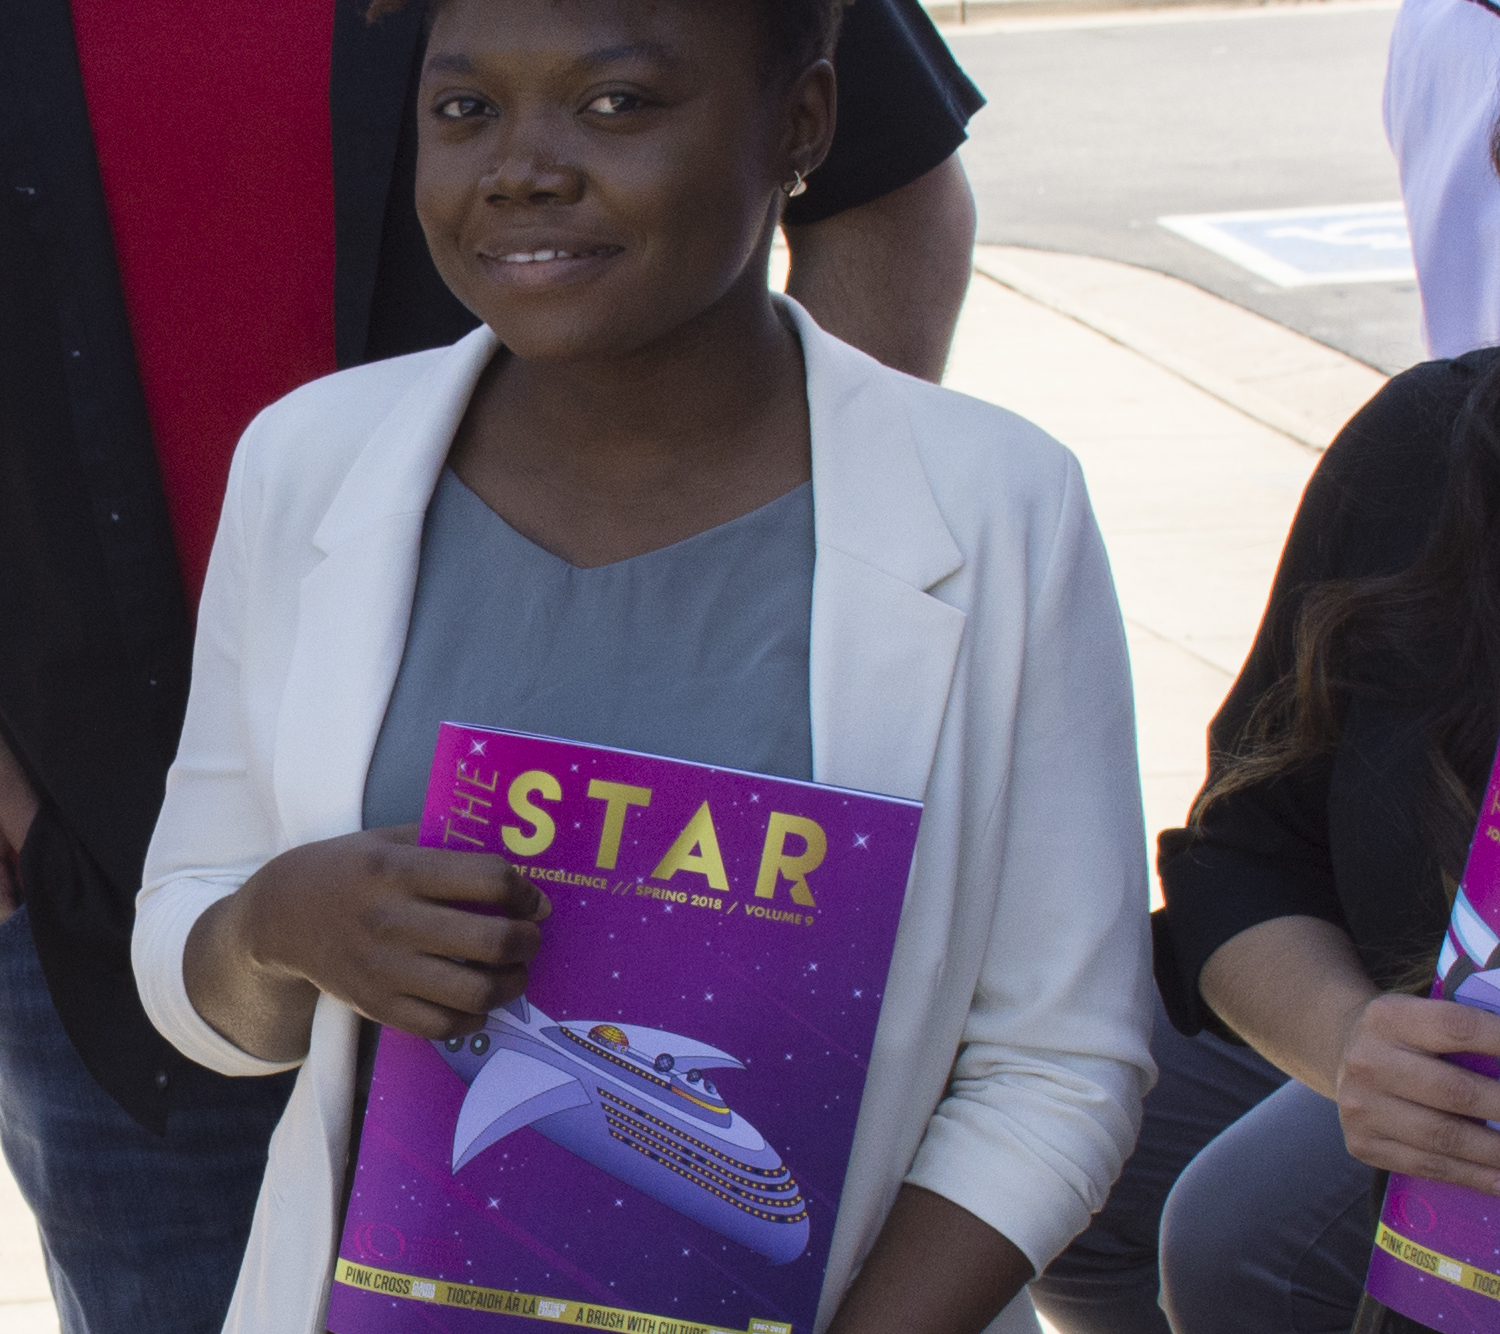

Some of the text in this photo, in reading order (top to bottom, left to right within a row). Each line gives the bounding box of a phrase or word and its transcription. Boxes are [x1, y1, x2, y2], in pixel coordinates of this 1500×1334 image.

[443, 758, 498, 846] THE
[501, 770, 827, 907] STAR
[530, 866, 608, 890] EXCELLENCE
[635, 884, 688, 903] SPRING
[691, 895, 723, 910] 2018
[745, 903, 802, 925] VOLUME
[805, 915, 815, 927] 9
[1380, 1230, 1404, 1254] PINK
[1403, 1244, 1438, 1271] CROSS
[345, 1266, 373, 1287] PINK
[373, 1273, 411, 1295] CROSS
[446, 1287, 501, 1309] TIOCFAIDH
[505, 1292, 521, 1313] ÁR
[522, 1297, 536, 1315] LÁ
[575, 1307, 584, 1322] A
[586, 1308, 624, 1329] BRUSH
[627, 1316, 656, 1334] WITH
